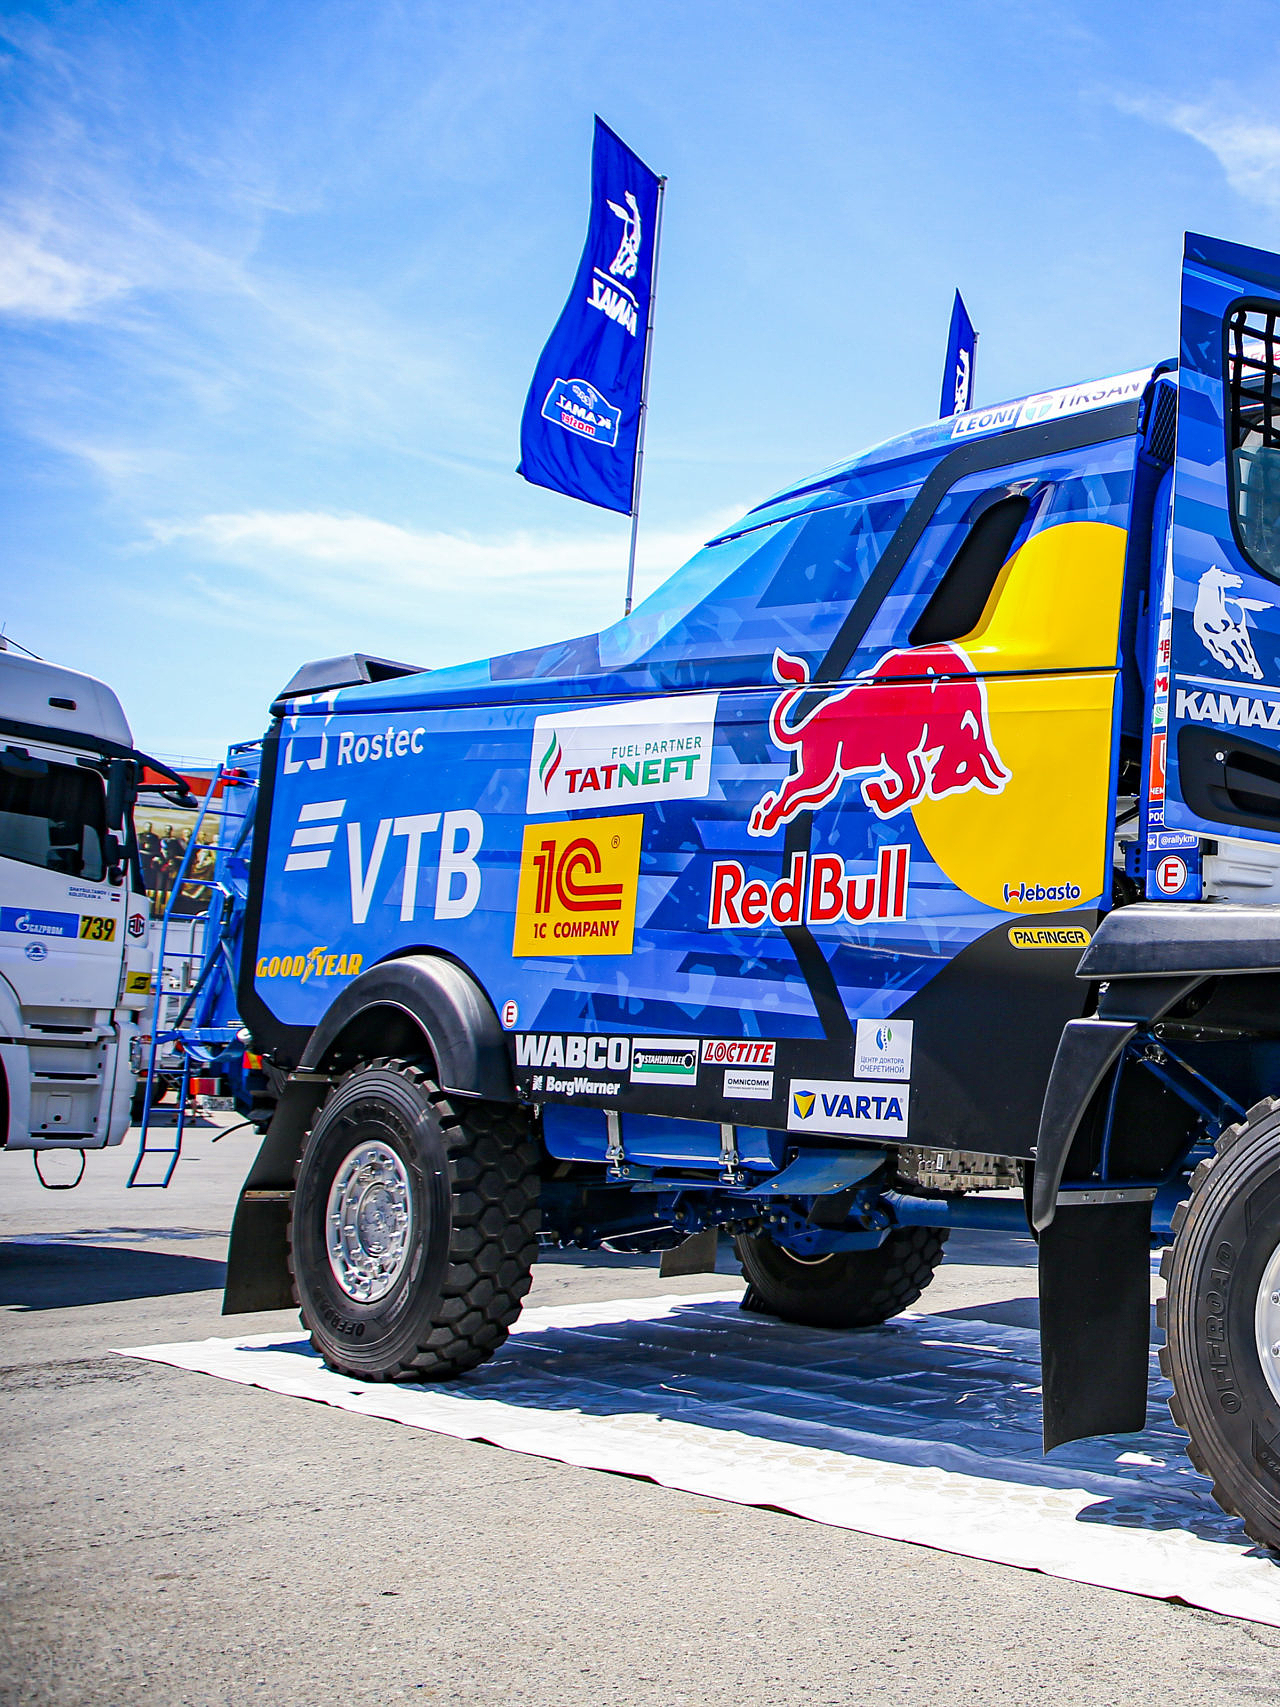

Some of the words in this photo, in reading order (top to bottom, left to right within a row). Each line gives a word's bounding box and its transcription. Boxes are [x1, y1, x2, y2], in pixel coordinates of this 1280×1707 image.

[956, 407, 1016, 434] LEONI
[336, 726, 426, 767] Rostec
[611, 742, 642, 758] FUEL
[644, 736, 703, 756] PARTNER
[564, 754, 701, 795] TATNEFT
[346, 808, 486, 926] VTB
[1164, 863, 1179, 887] E
[708, 852, 807, 929] Red
[807, 843, 911, 926] Bull
[1003, 882, 1081, 905] Webasto
[81, 916, 115, 941] 739
[533, 923, 551, 940] 1C
[553, 920, 620, 940] COMPANY
[1014, 929, 1086, 945] PALFINGER
[255, 945, 364, 985] GOODYEAR
[505, 1005, 515, 1023] E
[515, 1034, 630, 1071] WABCO
[704, 1042, 774, 1063] LOCTITE
[861, 1056, 879, 1064] ЦЕНТР
[859, 1064, 905, 1074] ОЧЕРЕТИНОЙ
[546, 1076, 621, 1097] BorgWarner
[727, 1077, 770, 1087] OMNICOMM
[821, 1093, 904, 1122] VARTA
